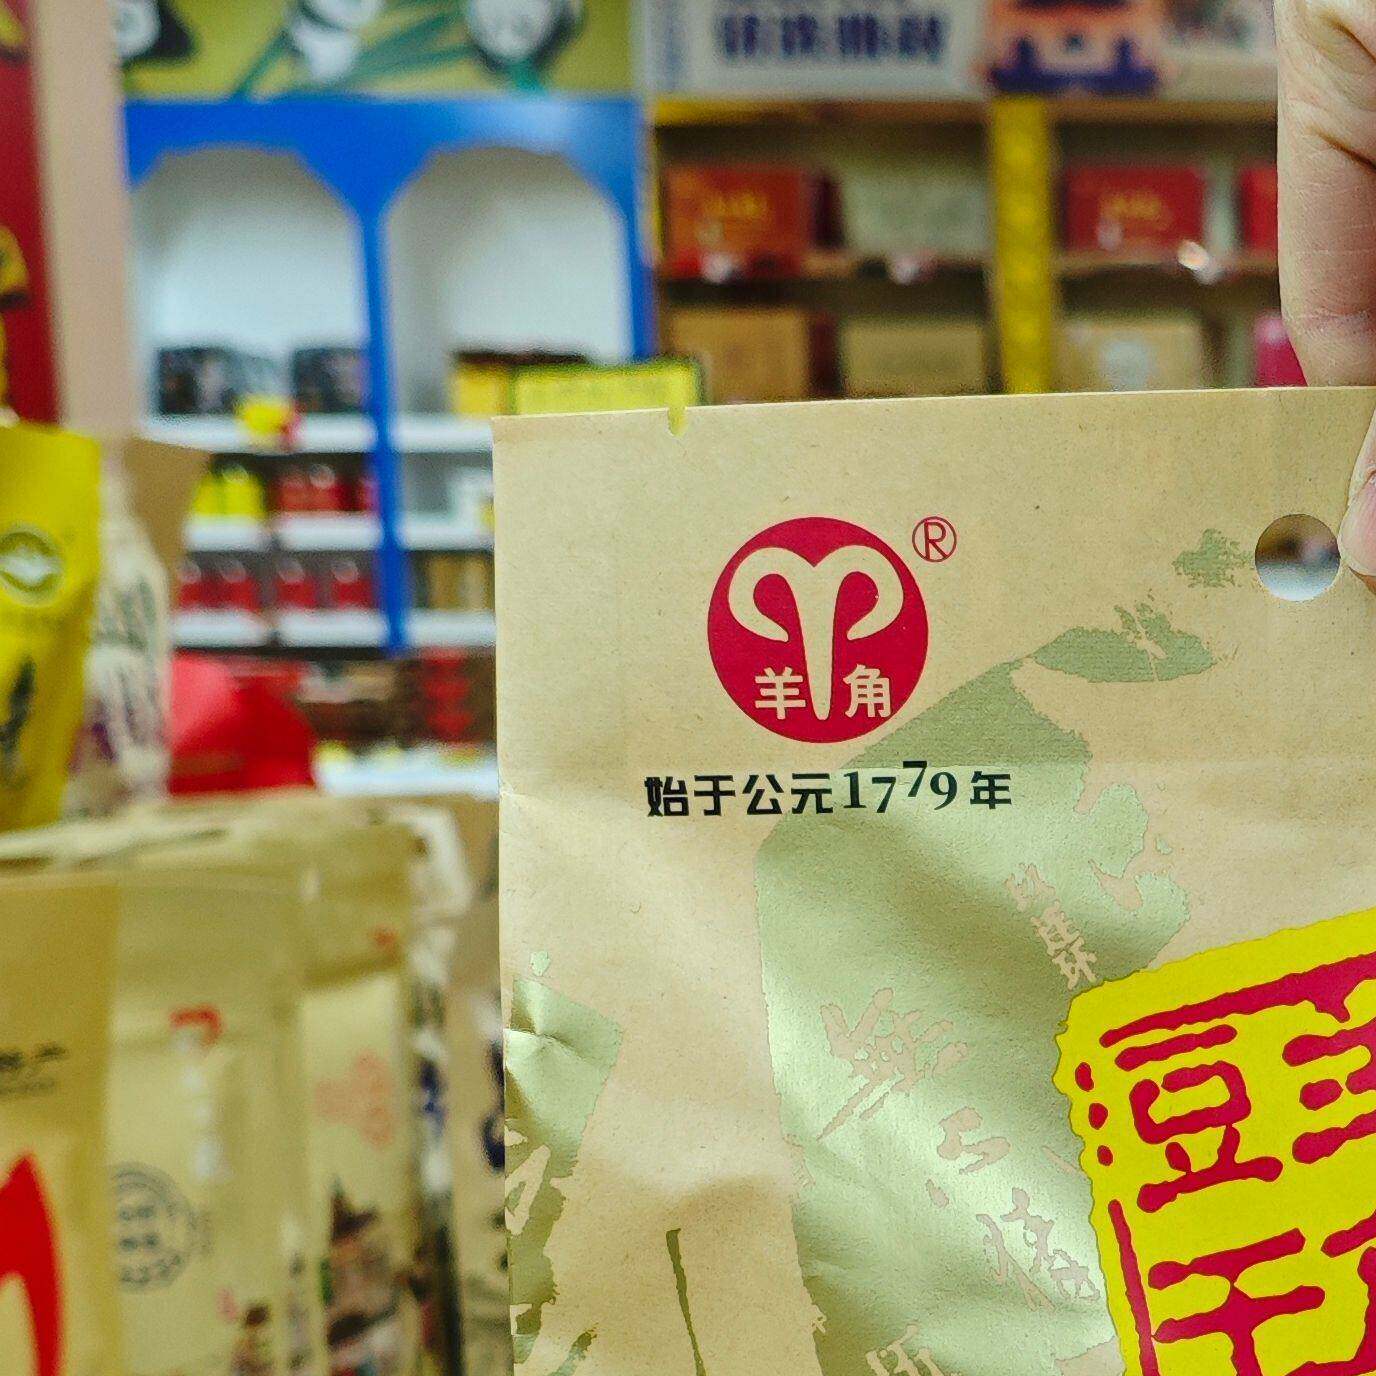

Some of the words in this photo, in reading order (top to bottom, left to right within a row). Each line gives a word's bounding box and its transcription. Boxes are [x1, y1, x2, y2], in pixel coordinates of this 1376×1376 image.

[754, 664, 891, 720] 羊角
[645, 760, 1013, 818] 始于公元1779年
